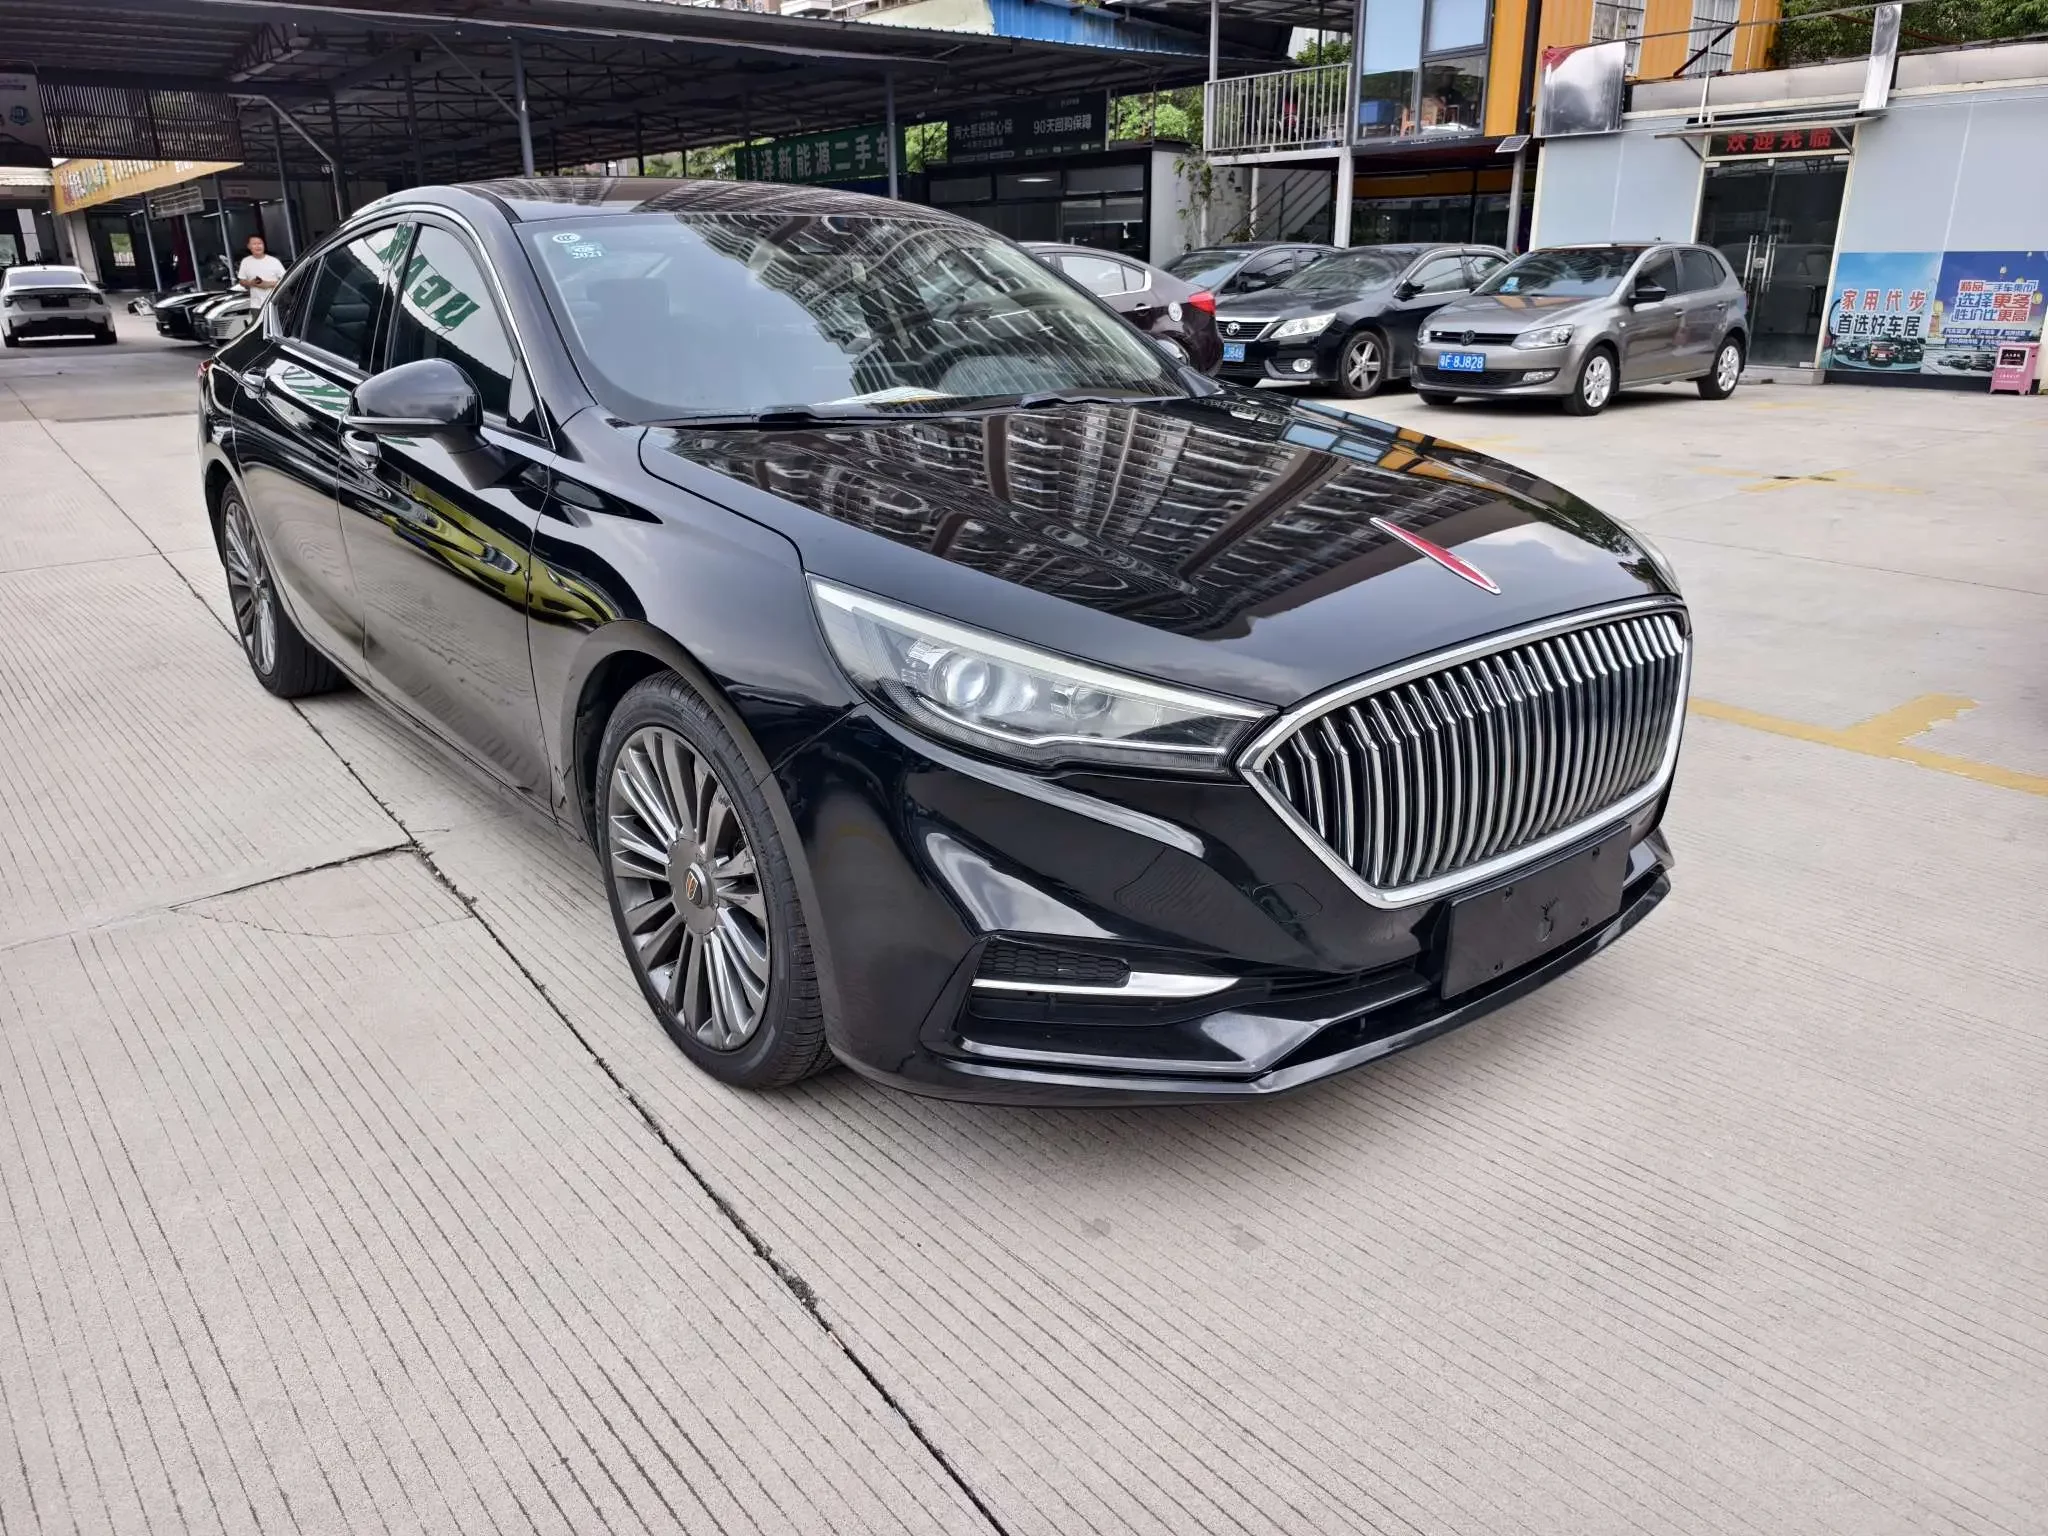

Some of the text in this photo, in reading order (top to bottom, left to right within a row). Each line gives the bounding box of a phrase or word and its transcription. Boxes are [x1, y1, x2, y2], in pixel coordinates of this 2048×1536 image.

[1726, 127, 1833, 152] 欢迎光临
[1840, 289, 1927, 312] 家用代步
[1956, 292, 2031, 309] 选择更多
[1837, 313, 1921, 337] 首选好车居
[1952, 308, 2029, 322] 性价比更高
